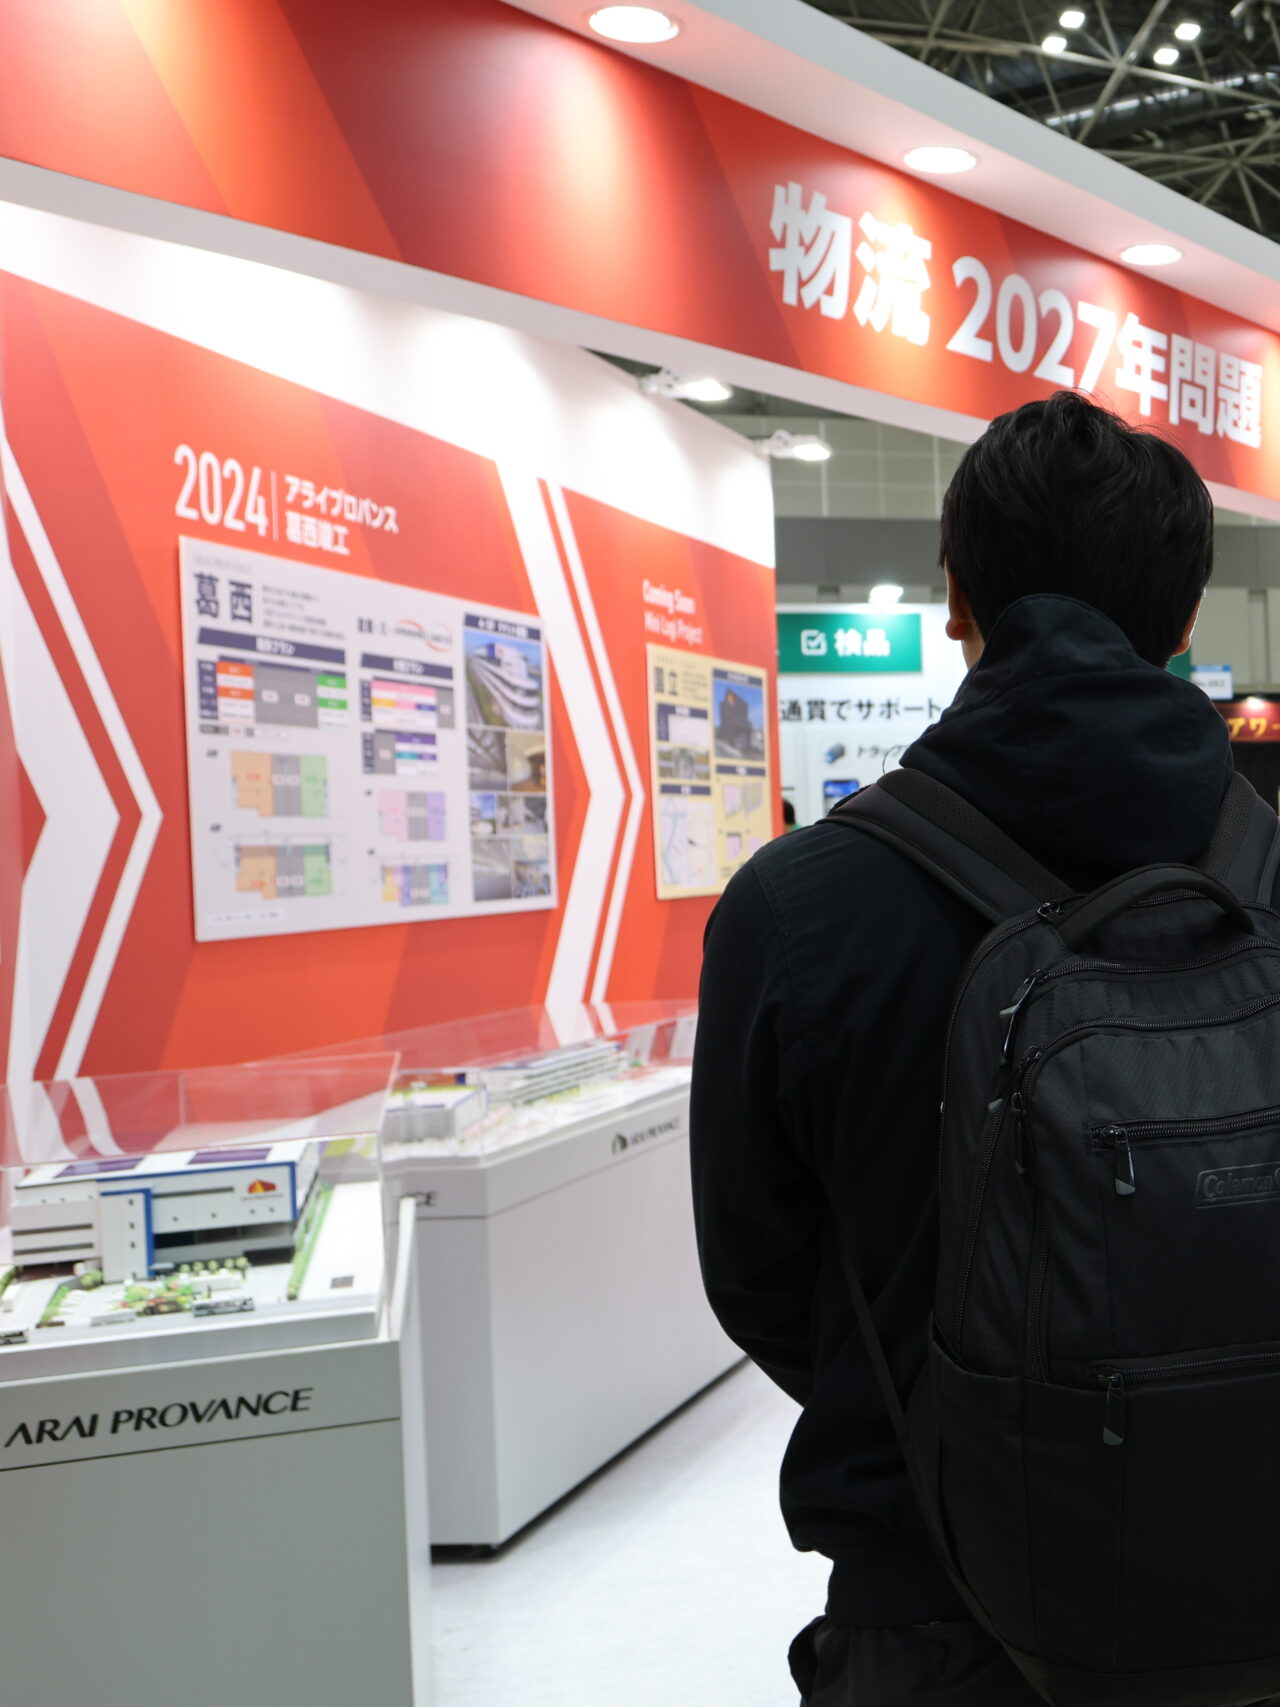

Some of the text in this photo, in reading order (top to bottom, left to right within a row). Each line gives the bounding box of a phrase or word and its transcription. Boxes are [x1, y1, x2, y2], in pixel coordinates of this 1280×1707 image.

[768, 181, 1263, 449] 物流 2027年問題
[173, 444, 269, 537] 2024
[284, 474, 399, 534] アライプロバンス
[193, 573, 254, 625] 葛西
[834, 628, 891, 657] 検品
[1202, 1173, 1273, 1199] Coleman
[4, 1387, 315, 1448] ARAI PROVANCE
